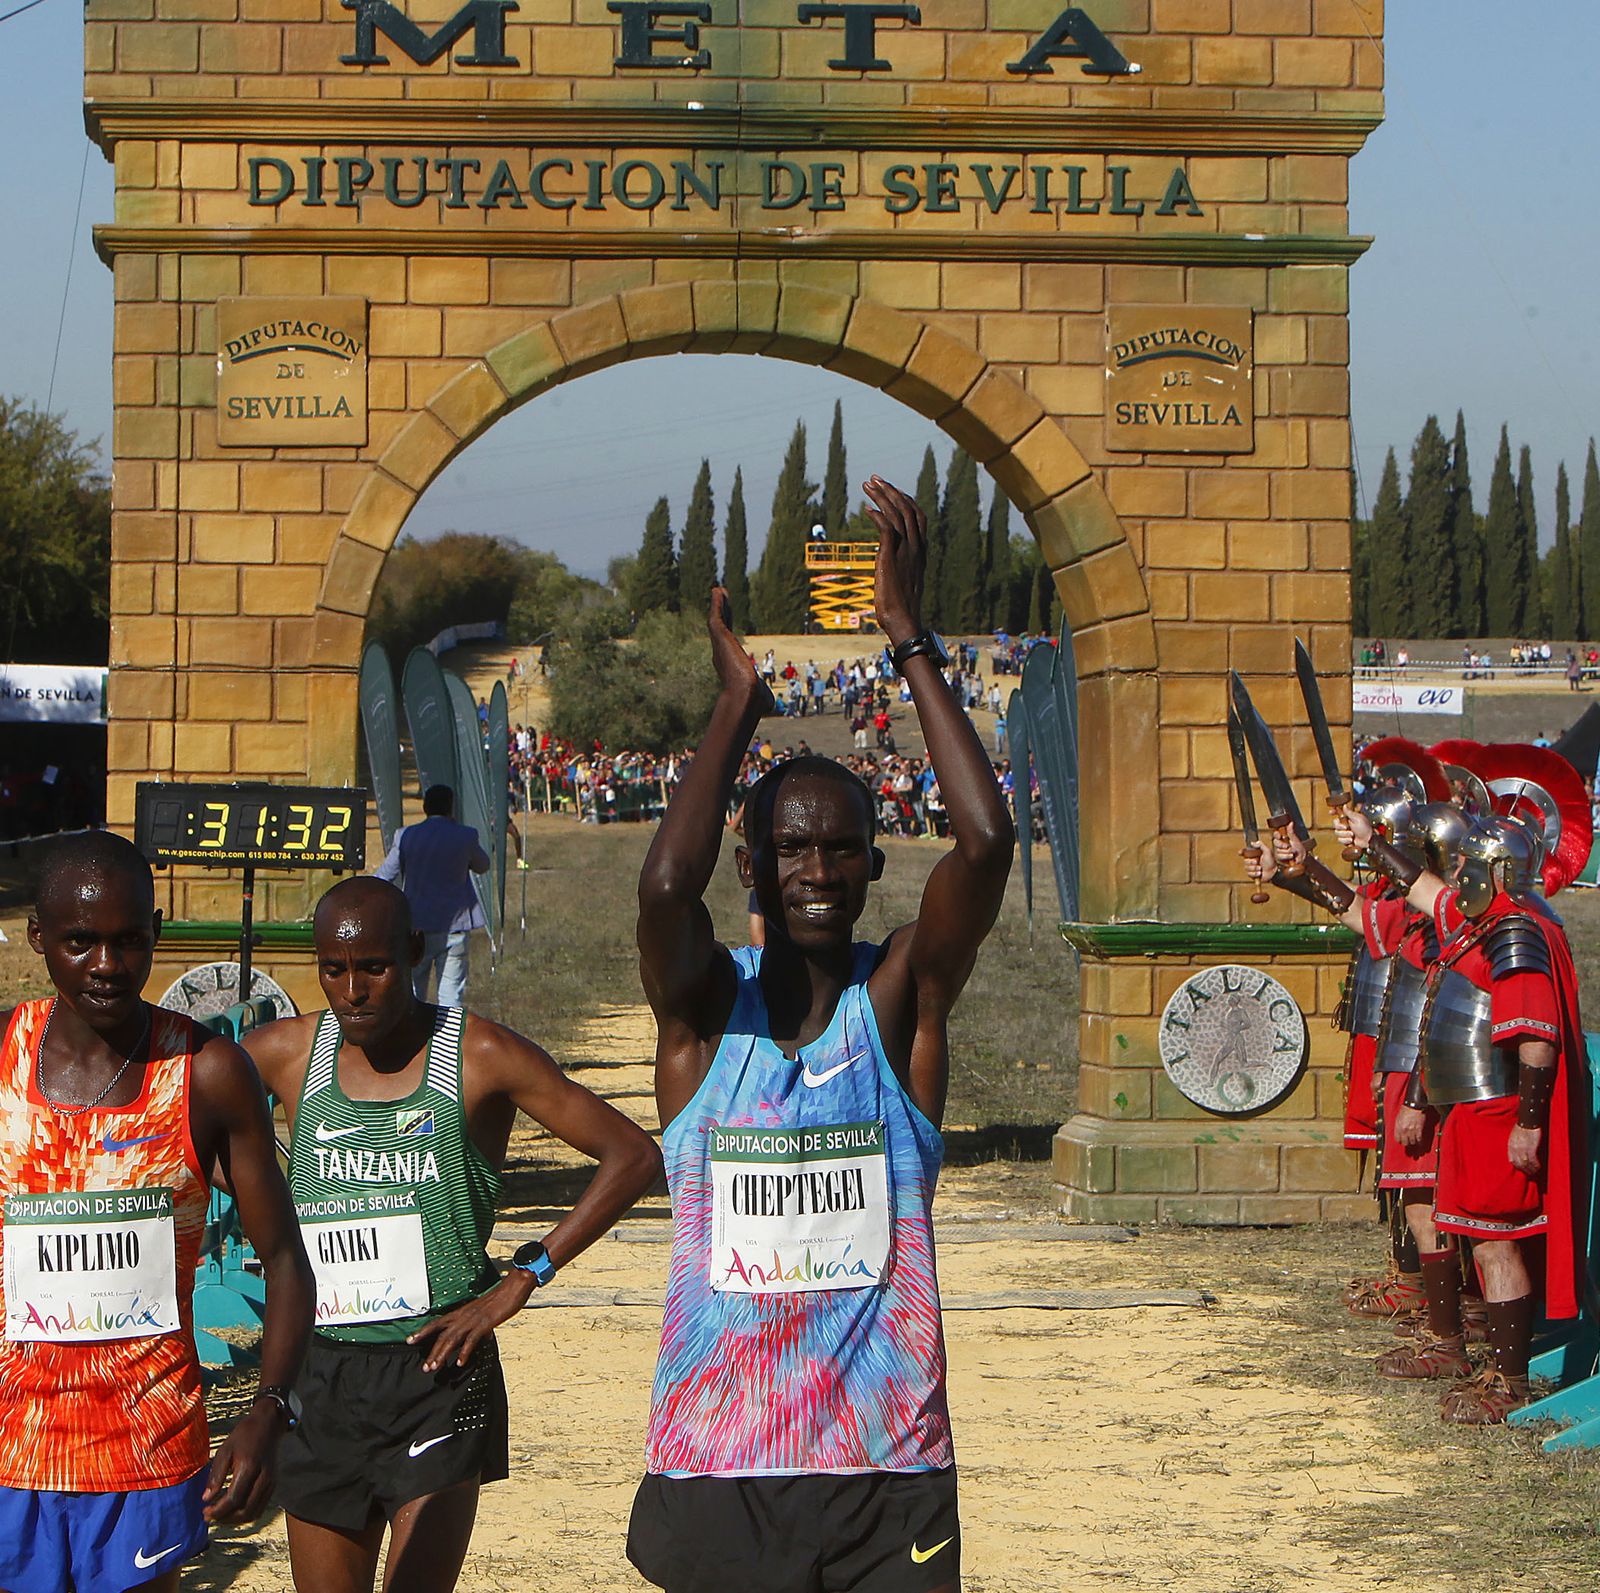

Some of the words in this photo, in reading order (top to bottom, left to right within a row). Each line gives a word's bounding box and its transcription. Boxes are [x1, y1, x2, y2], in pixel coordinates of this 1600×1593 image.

[339, 0, 1142, 75] META
[248, 156, 725, 211] DIPUTACION
[760, 161, 846, 211] DE
[882, 163, 1204, 216] SEVILLA
[225, 320, 363, 358] DIPUTACION
[1113, 328, 1247, 363] DIPUTACION
[276, 363, 305, 379] DE
[1163, 371, 1192, 386] DE
[227, 395, 353, 419] SEVILLA
[1116, 402, 1243, 426] SEVILLA
[15, 688, 32, 699] DE
[38, 688, 95, 702] SEVILLA
[1417, 688, 1453, 706] evo
[157, 848, 245, 860] www.gescon-chip.com
[249, 852, 262, 860] 615
[1165, 968, 1299, 1068] ITALICA
[715, 1135, 801, 1154] DIPUTACION
[804, 1134, 821, 1152] DE
[826, 1127, 878, 1150] SEVILLA
[313, 1148, 441, 1183] TANZANIA
[9, 1198, 91, 1217] DIPUTACION
[95, 1198, 113, 1214] DE
[117, 1194, 168, 1213] SEVILLA
[350, 1199, 366, 1213] DE
[369, 1193, 416, 1211] SEVILLA
[731, 1167, 867, 1217] CHEPTEGEI
[37, 1230, 140, 1272] KIPLIMO
[317, 1227, 379, 1265] GINIKI
[724, 1243, 878, 1287] Andalucía
[21, 1297, 164, 1336] Andalucía
[315, 1284, 413, 1321] ndalucía
